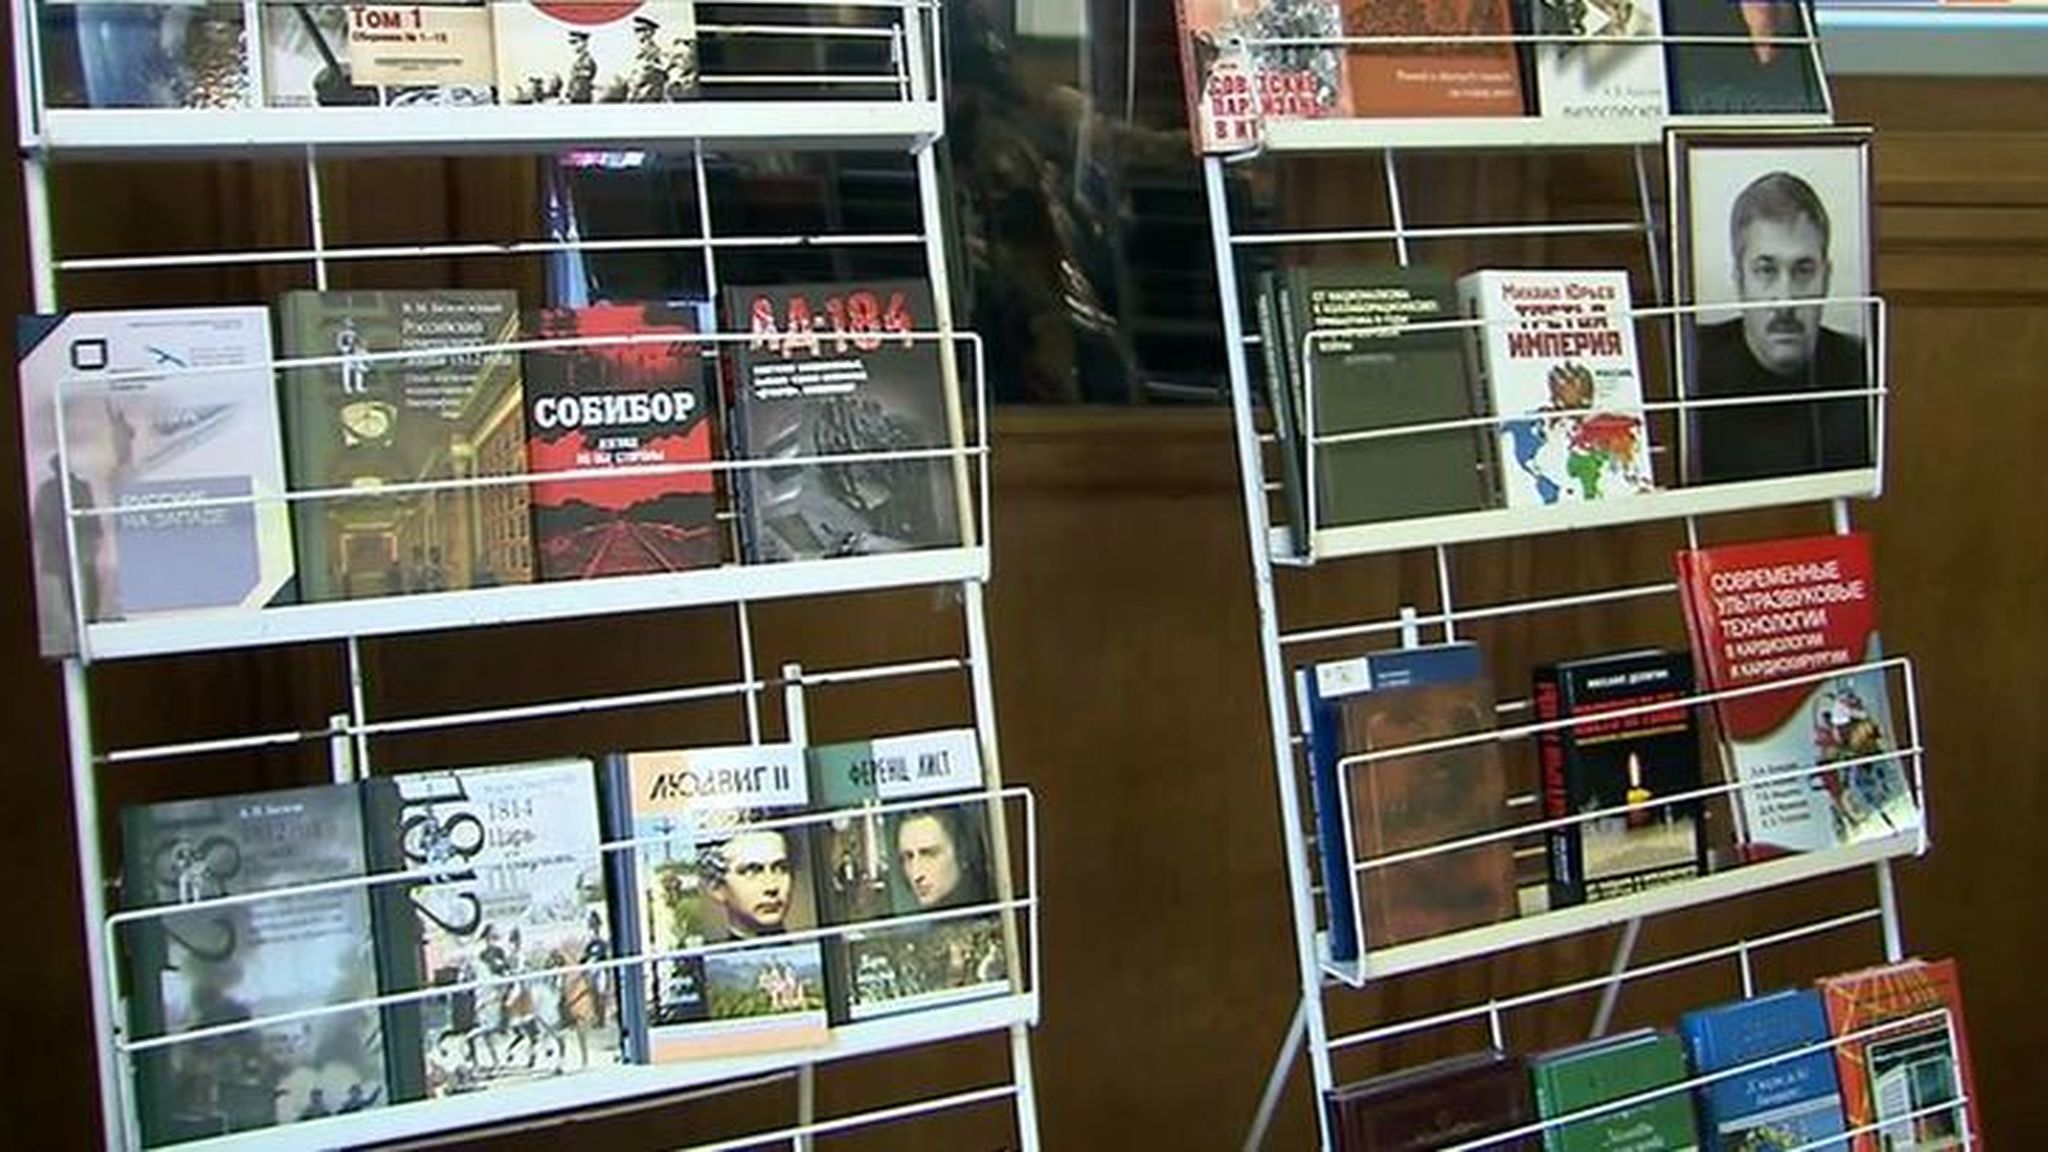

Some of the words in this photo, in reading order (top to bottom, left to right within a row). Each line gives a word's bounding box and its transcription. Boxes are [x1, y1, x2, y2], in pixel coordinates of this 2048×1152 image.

[351, 7, 402, 28] Том
[411, 8, 421, 28] 1
[1507, 331, 1623, 358] ИМПЕРИЯ
[534, 391, 695, 428] СОБИБОР
[1711, 560, 1841, 592] СОВРЕМЕННЫЕ
[1713, 580, 1866, 615] УЛЬТРАЗВУКОВЫЕ
[1721, 609, 1828, 638] ТЕХНОЛОГИИ
[650, 765, 768, 800] ЛЮДВИГ
[849, 758, 911, 787] ФЕРЕНЦ
[918, 750, 951, 777] ЛИСТ
